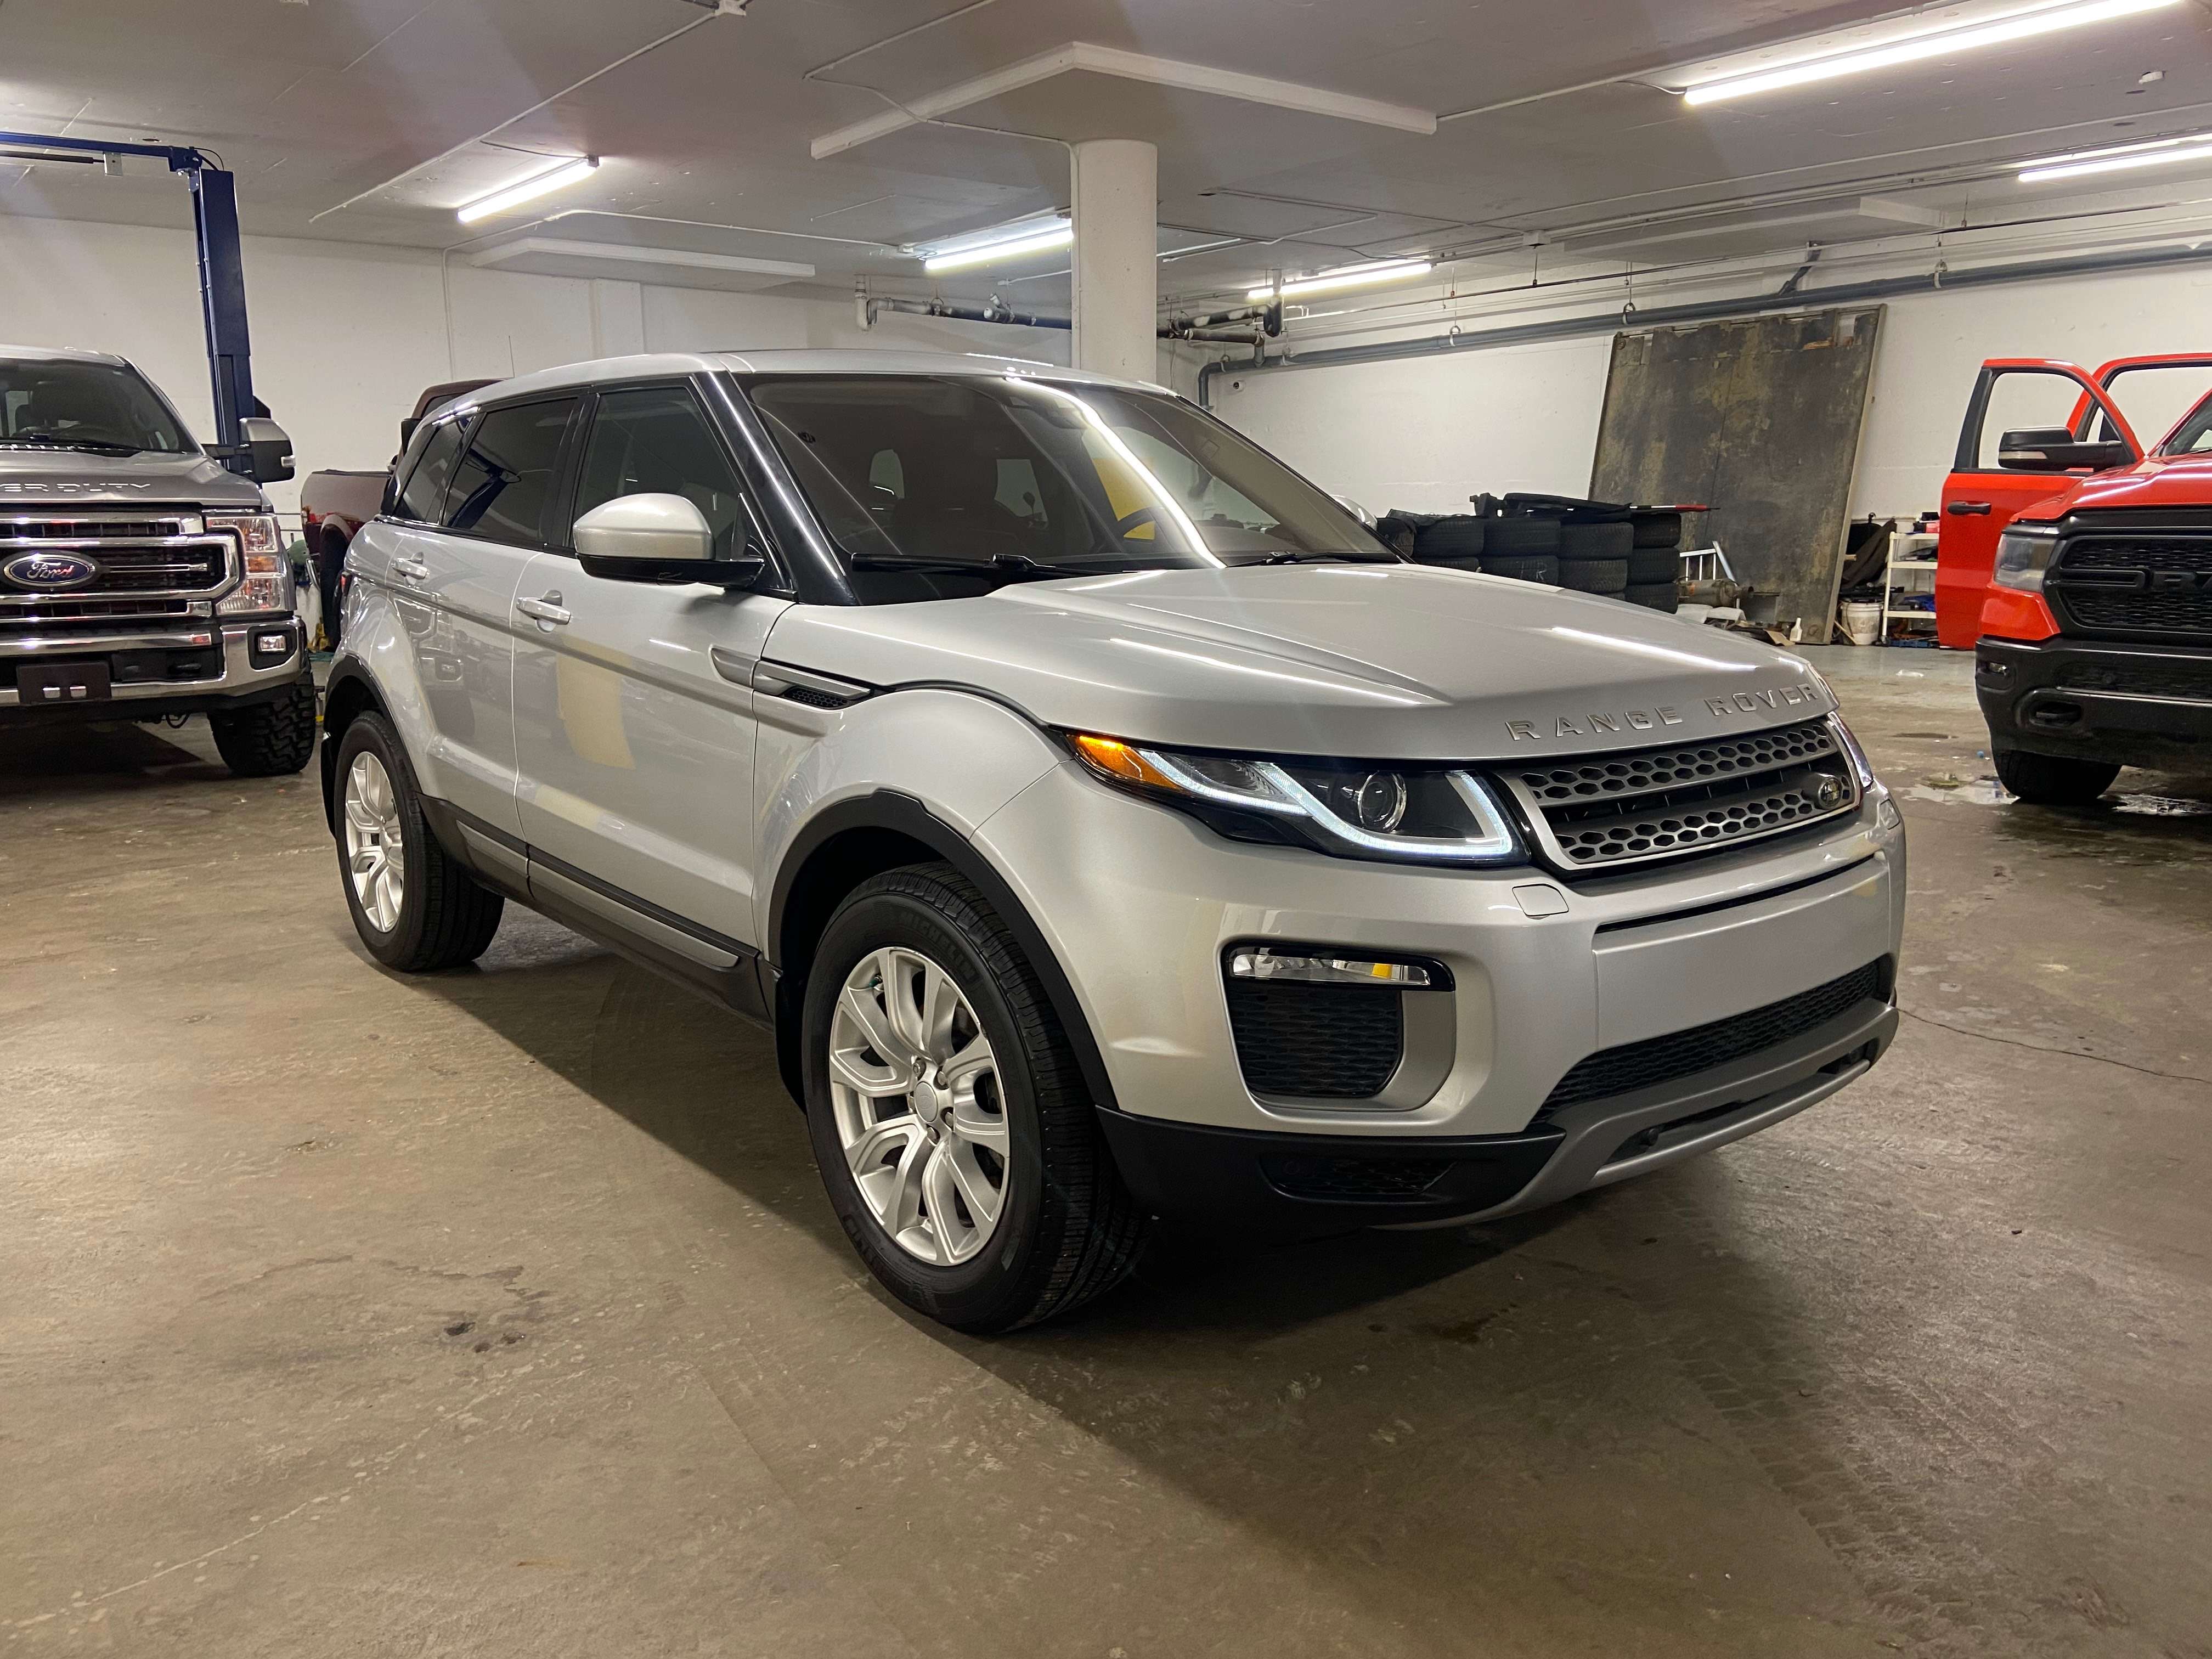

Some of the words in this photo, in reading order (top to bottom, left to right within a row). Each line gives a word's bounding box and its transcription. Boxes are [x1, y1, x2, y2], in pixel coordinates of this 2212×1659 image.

[57, 482, 151, 493] DUTY
[26, 561, 75, 579] Ford
[1504, 706, 1684, 741] RANGE
[1703, 683, 1818, 716] ROVER
[898, 910, 980, 983] MICHELIN
